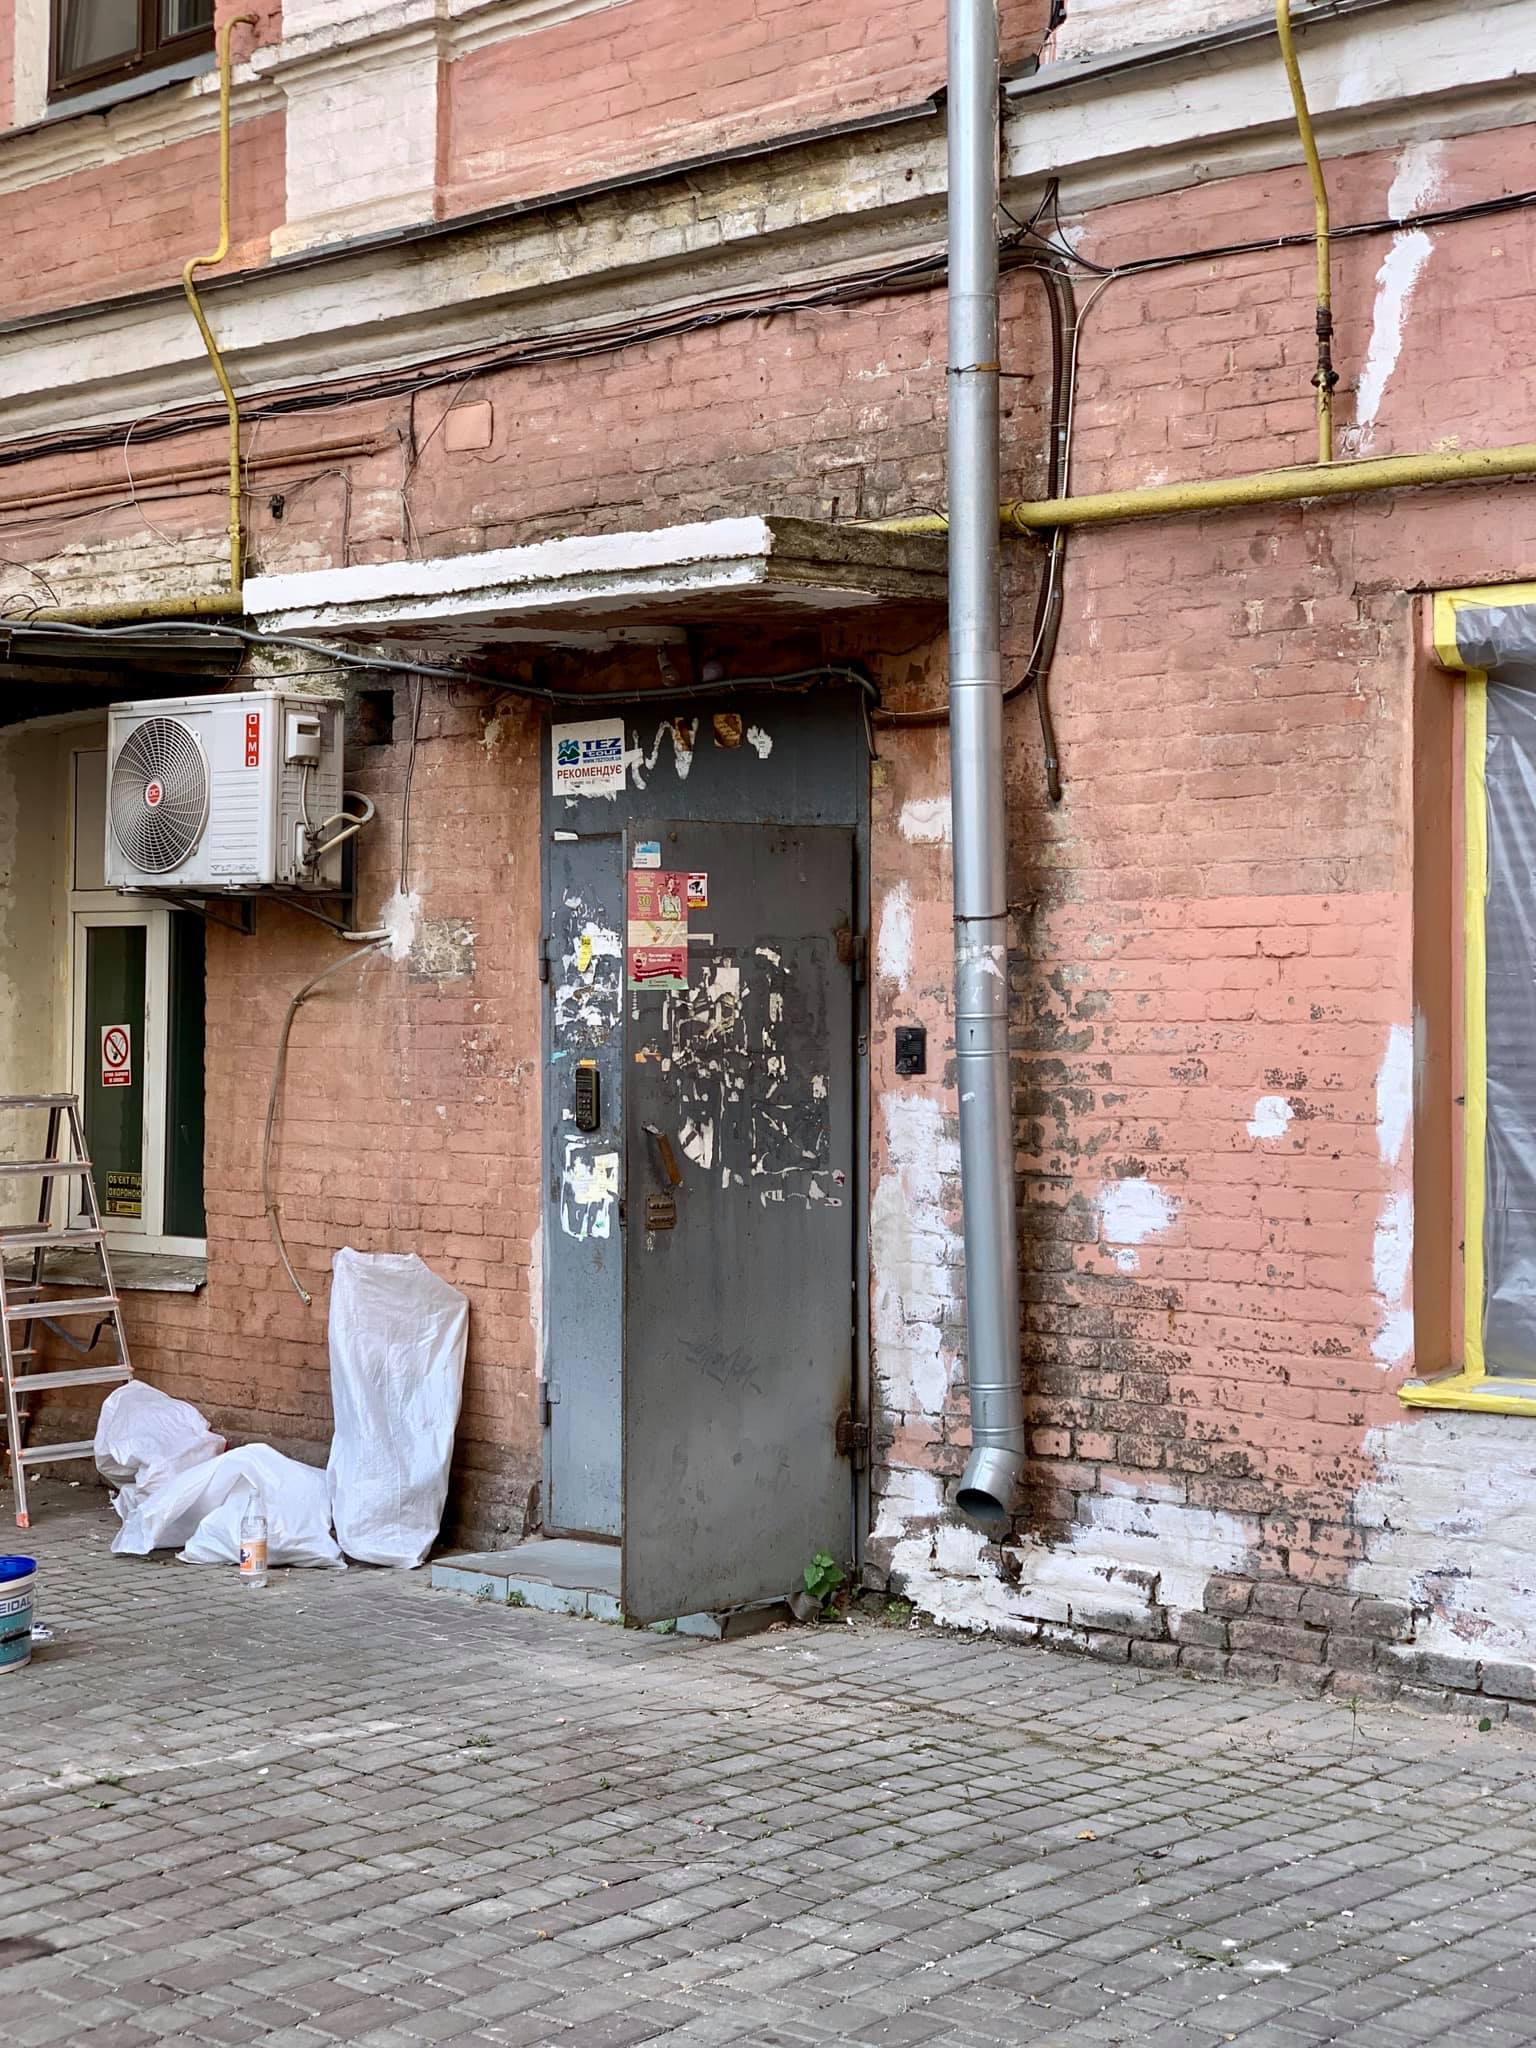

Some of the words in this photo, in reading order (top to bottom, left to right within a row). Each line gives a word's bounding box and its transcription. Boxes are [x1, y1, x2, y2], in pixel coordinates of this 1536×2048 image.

[248, 714, 257, 766] OLMO
[582, 738, 621, 750] TEZ
[557, 764, 623, 779] РЕКОМЕНДУЄ
